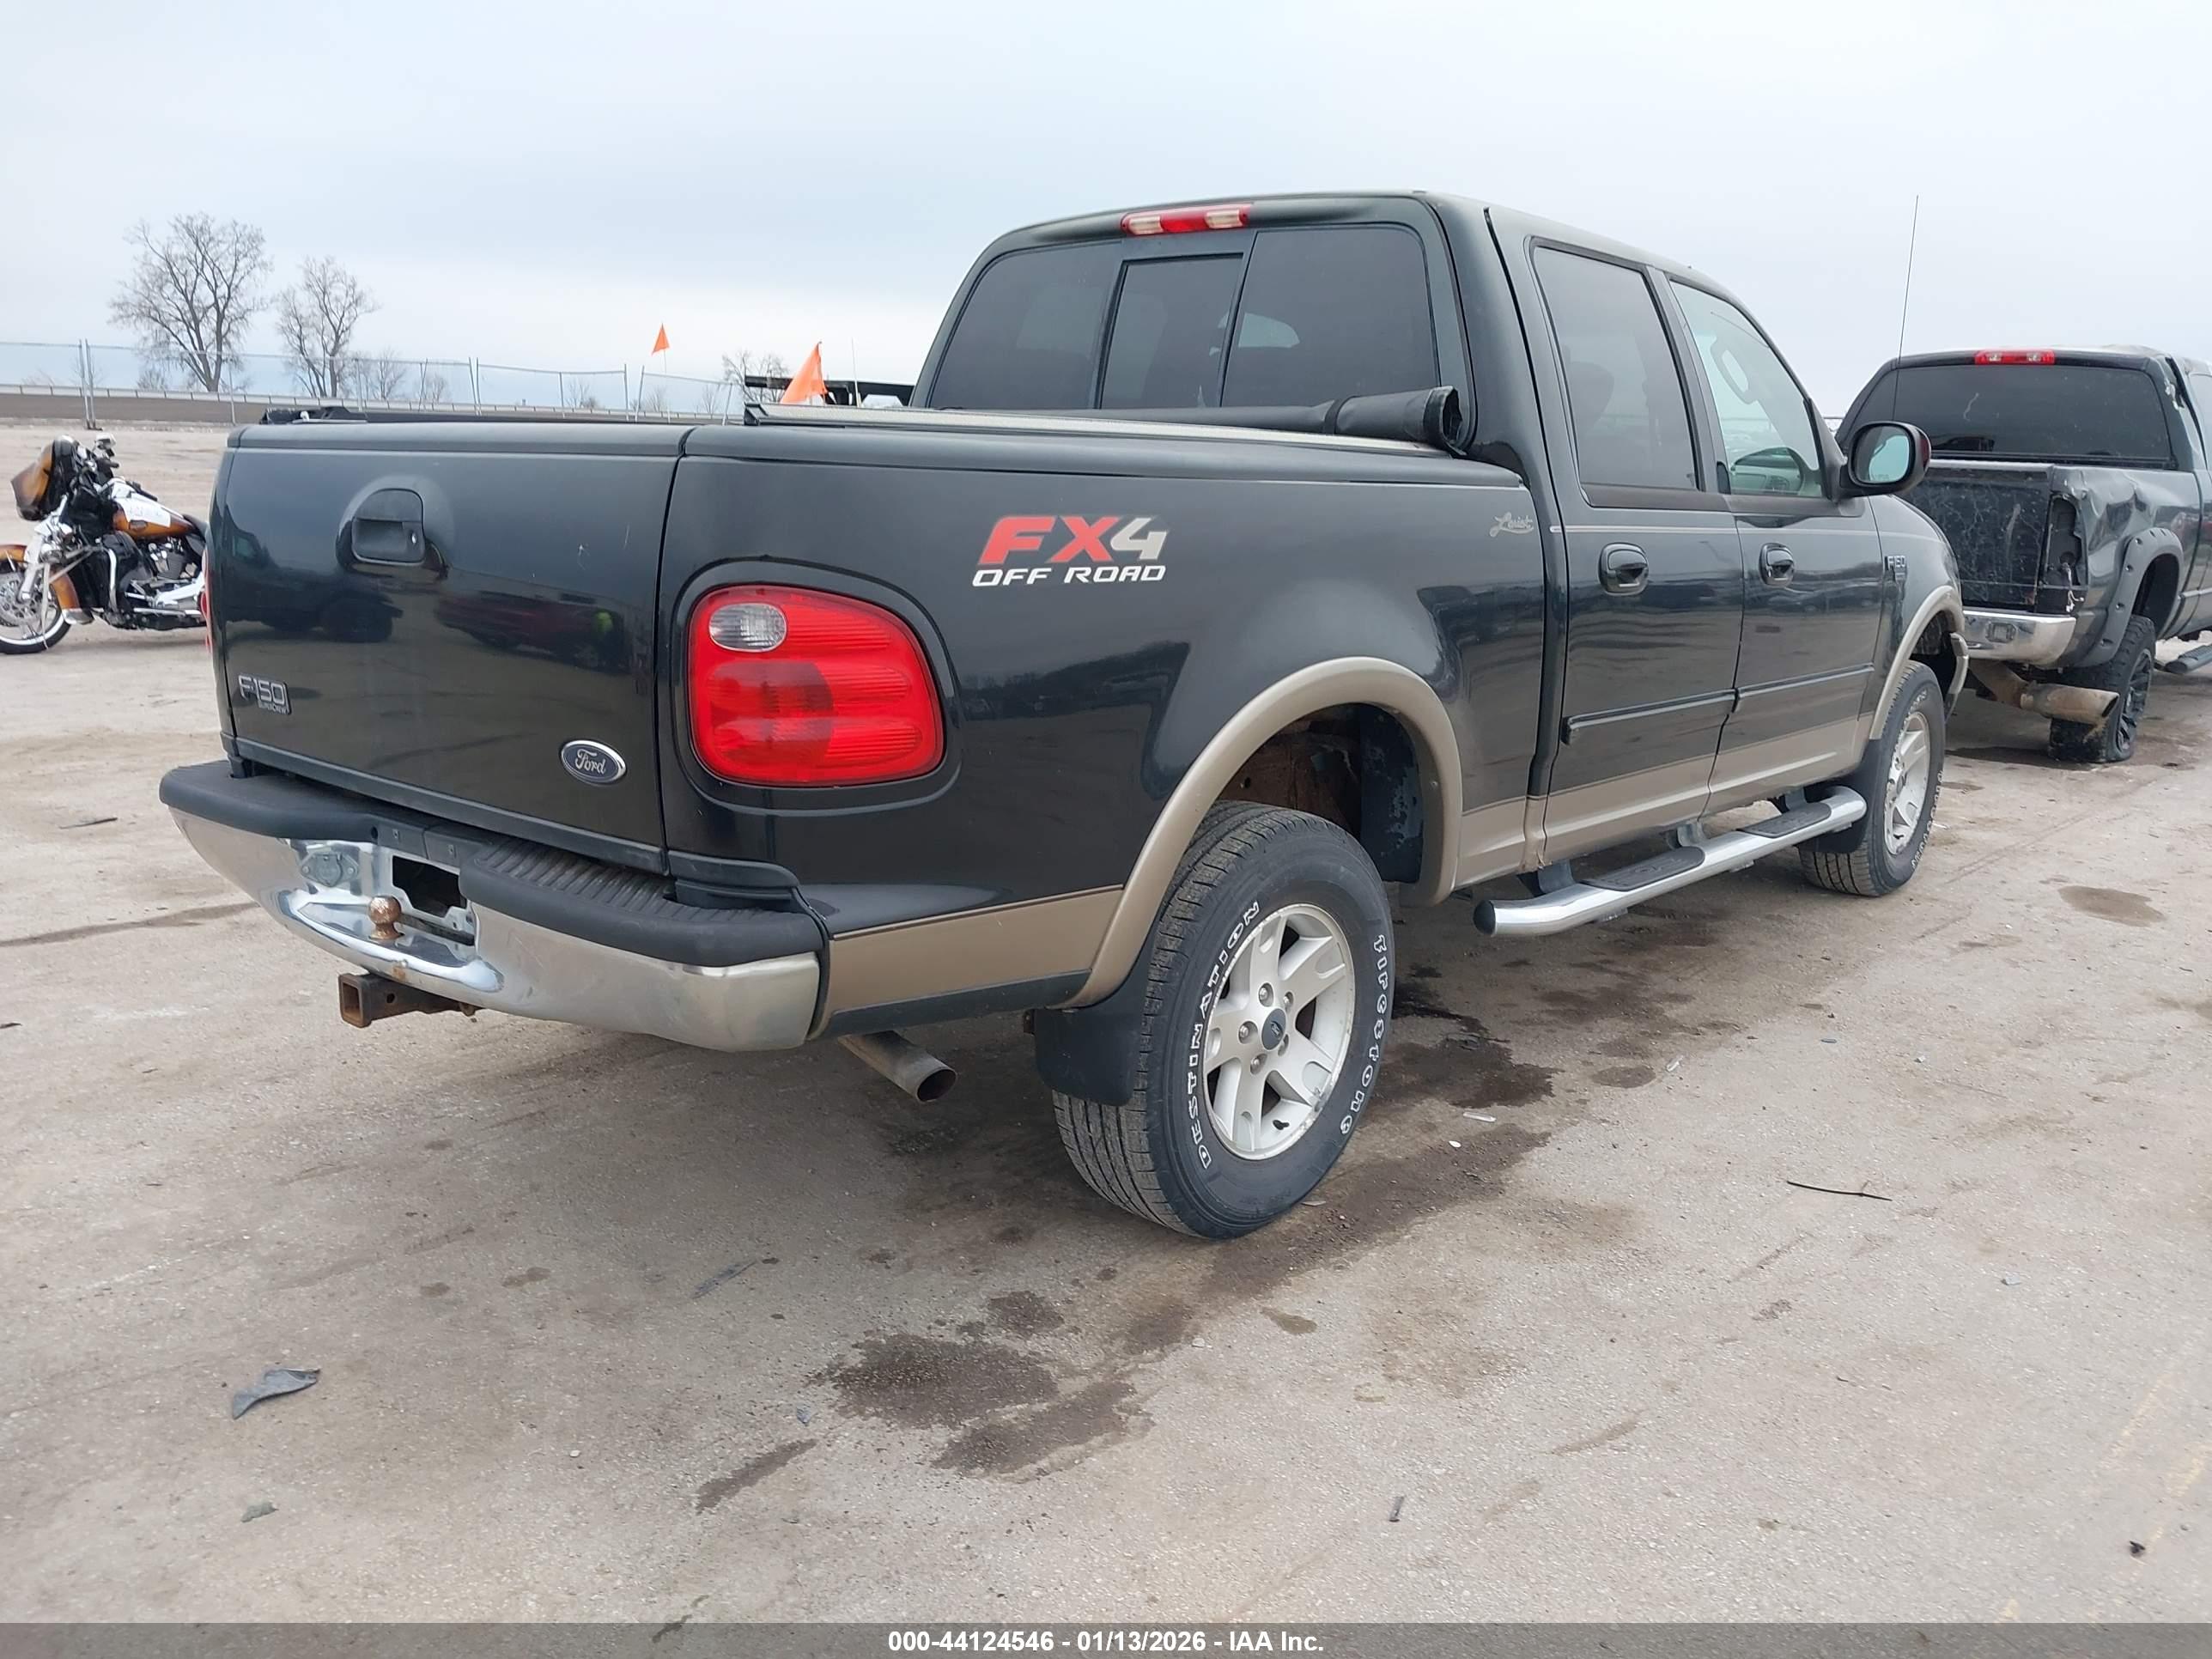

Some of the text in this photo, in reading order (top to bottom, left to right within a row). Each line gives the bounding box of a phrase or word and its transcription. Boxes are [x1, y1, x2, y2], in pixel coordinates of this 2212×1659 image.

[978, 515, 1169, 564] FX4
[972, 565, 1166, 586] OFF ROAD
[574, 748, 606, 775] Ford
[1188, 902, 1260, 1169] DESTINATION
